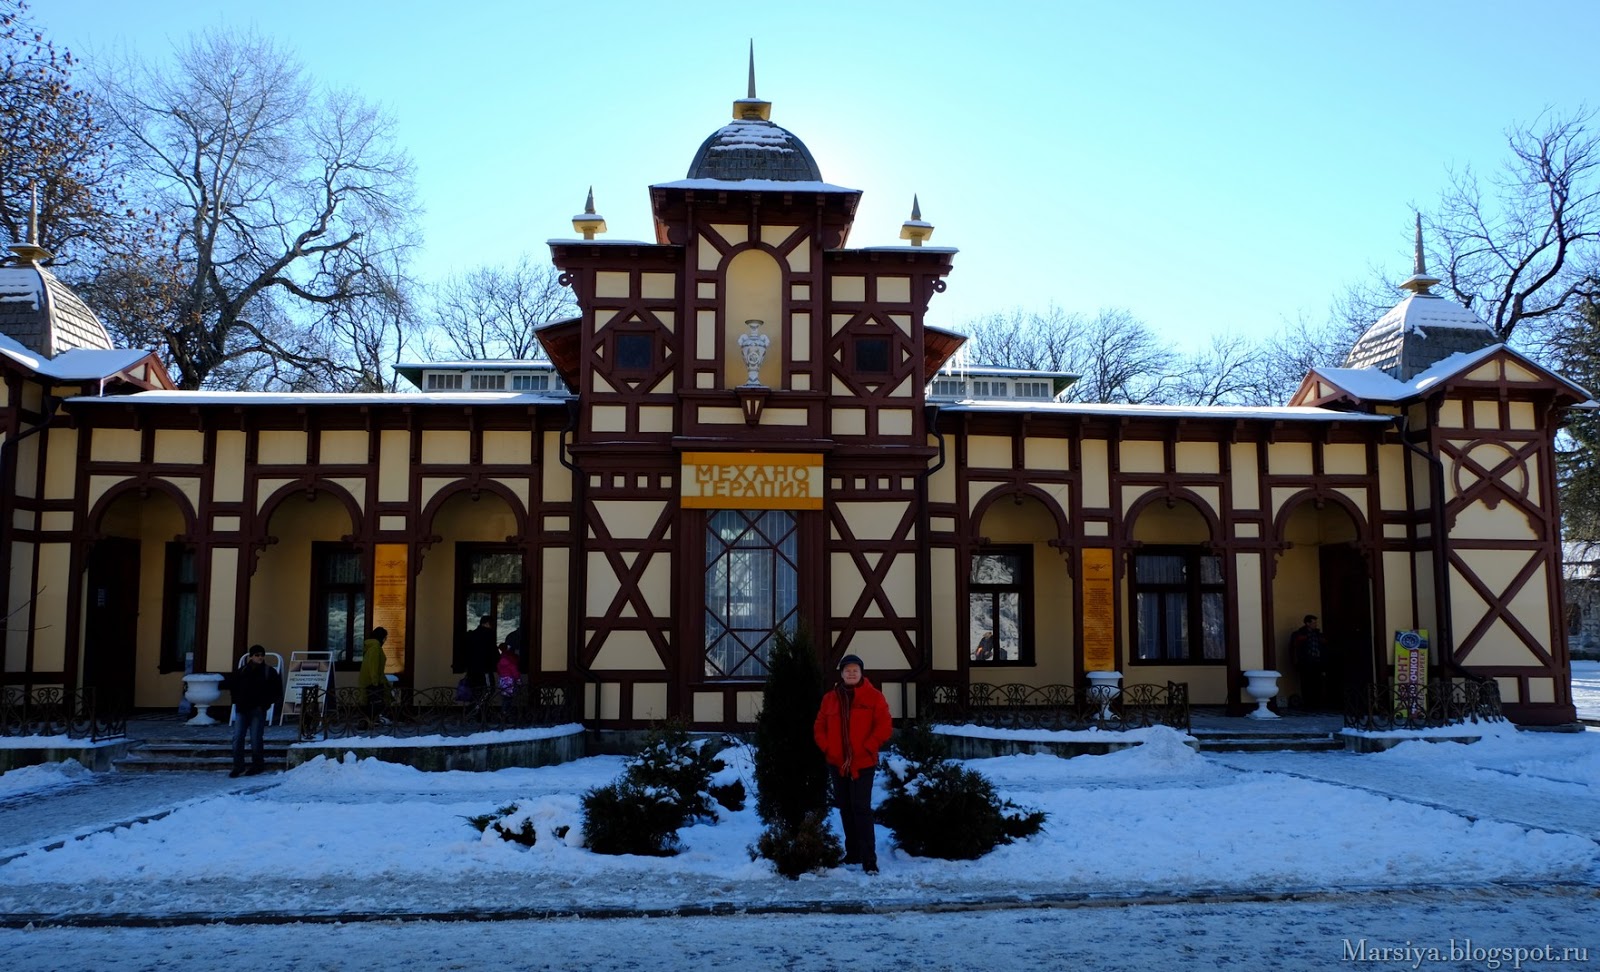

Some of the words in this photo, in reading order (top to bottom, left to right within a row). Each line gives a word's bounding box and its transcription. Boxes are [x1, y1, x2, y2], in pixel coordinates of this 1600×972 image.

[695, 465, 809, 482] МЕХАНО
[699, 480, 809, 498] ТЕРАПИЯ
[1410, 651, 1418, 681] ОЧКОВ
